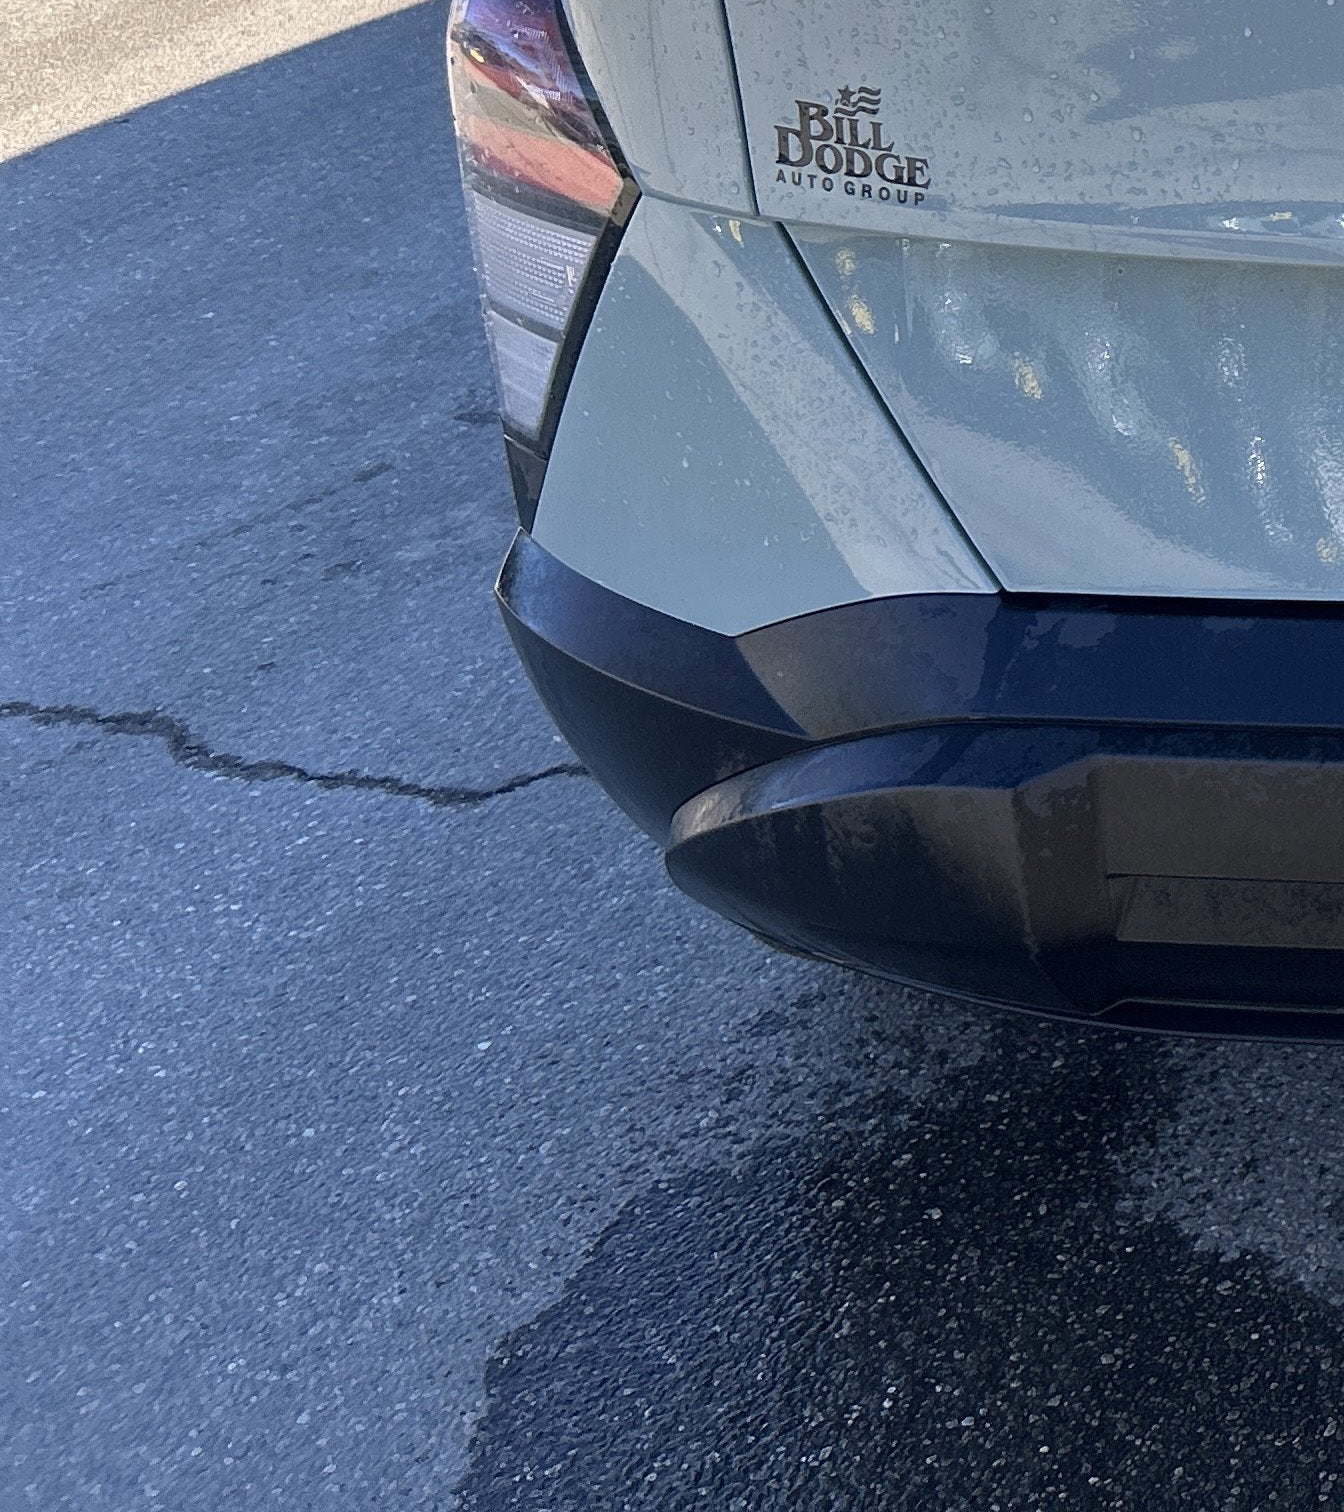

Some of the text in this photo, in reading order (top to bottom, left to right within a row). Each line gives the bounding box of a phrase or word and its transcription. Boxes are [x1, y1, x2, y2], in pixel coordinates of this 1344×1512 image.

[794, 100, 895, 153] BILL
[774, 125, 931, 190] DODGE
[775, 168, 925, 206] AUTO GROUP
